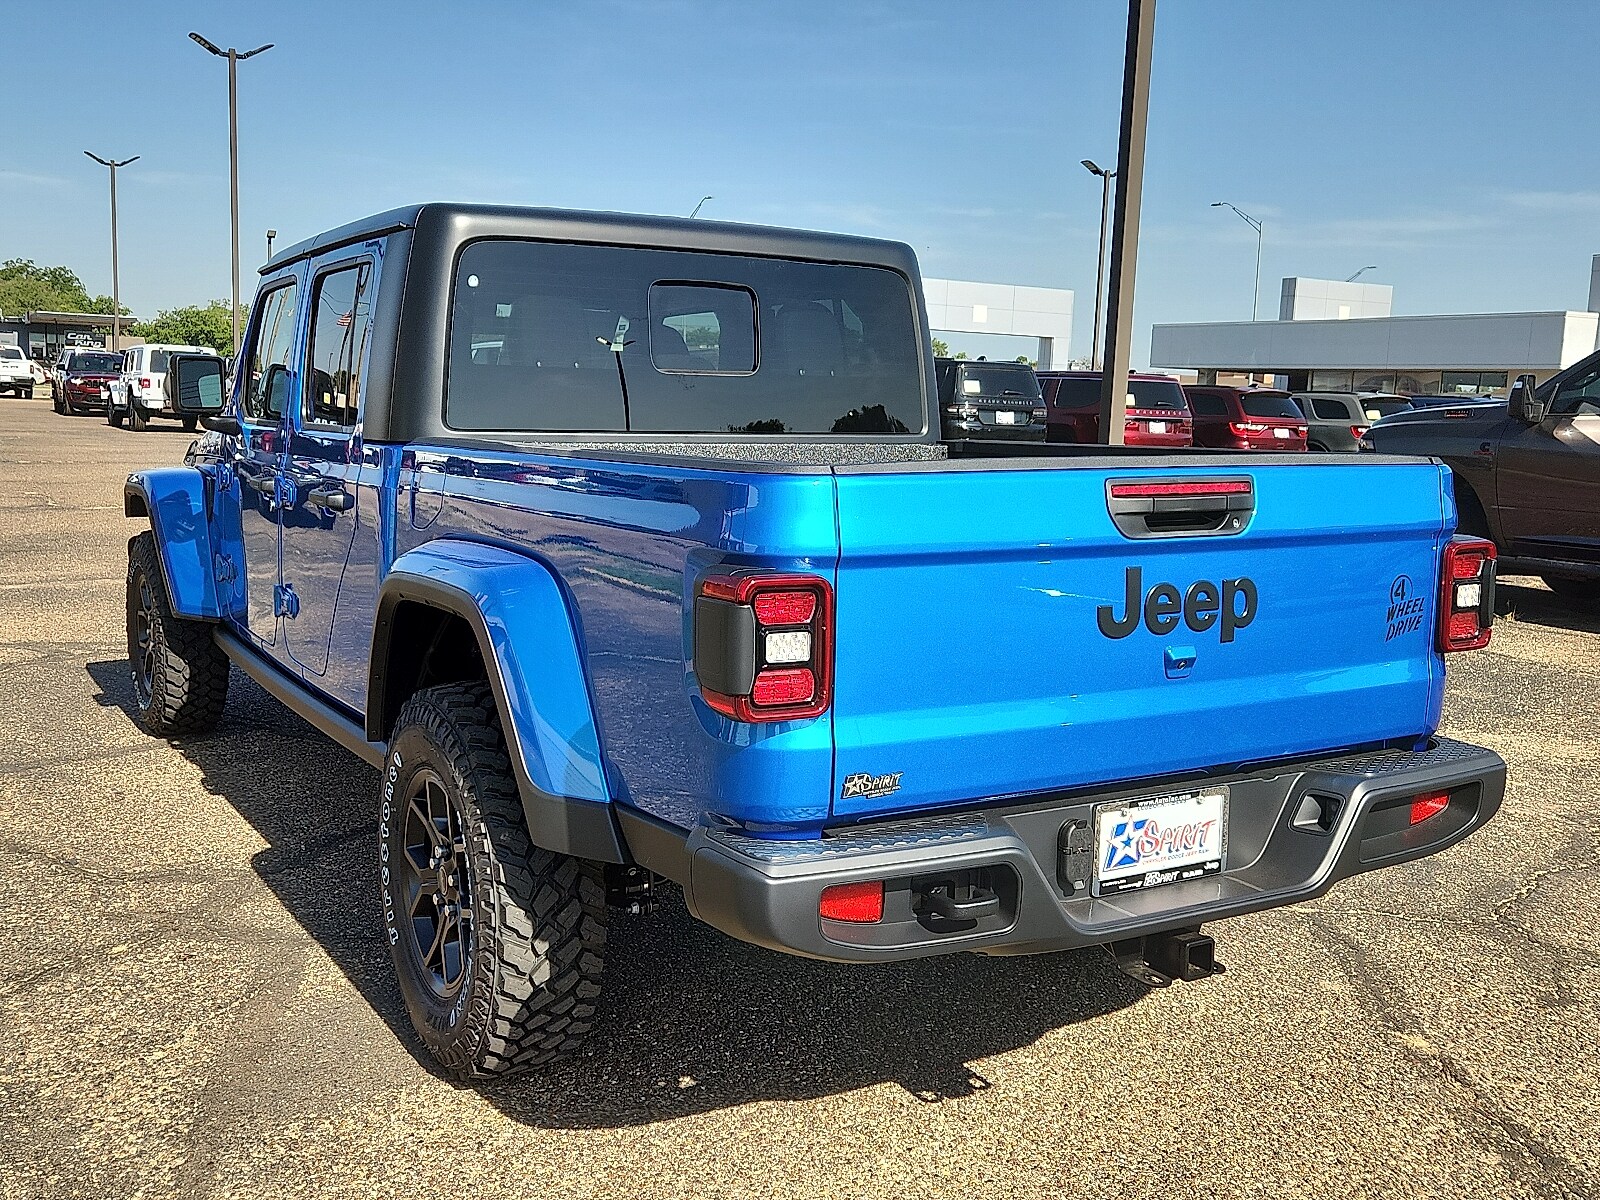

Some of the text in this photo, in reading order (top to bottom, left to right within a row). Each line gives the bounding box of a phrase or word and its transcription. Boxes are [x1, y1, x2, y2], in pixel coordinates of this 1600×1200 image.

[1393, 578, 1406, 601] 4
[1096, 565, 1258, 643] Jeep
[1386, 597, 1425, 623] WHEEL
[1385, 614, 1423, 642] DRIVE
